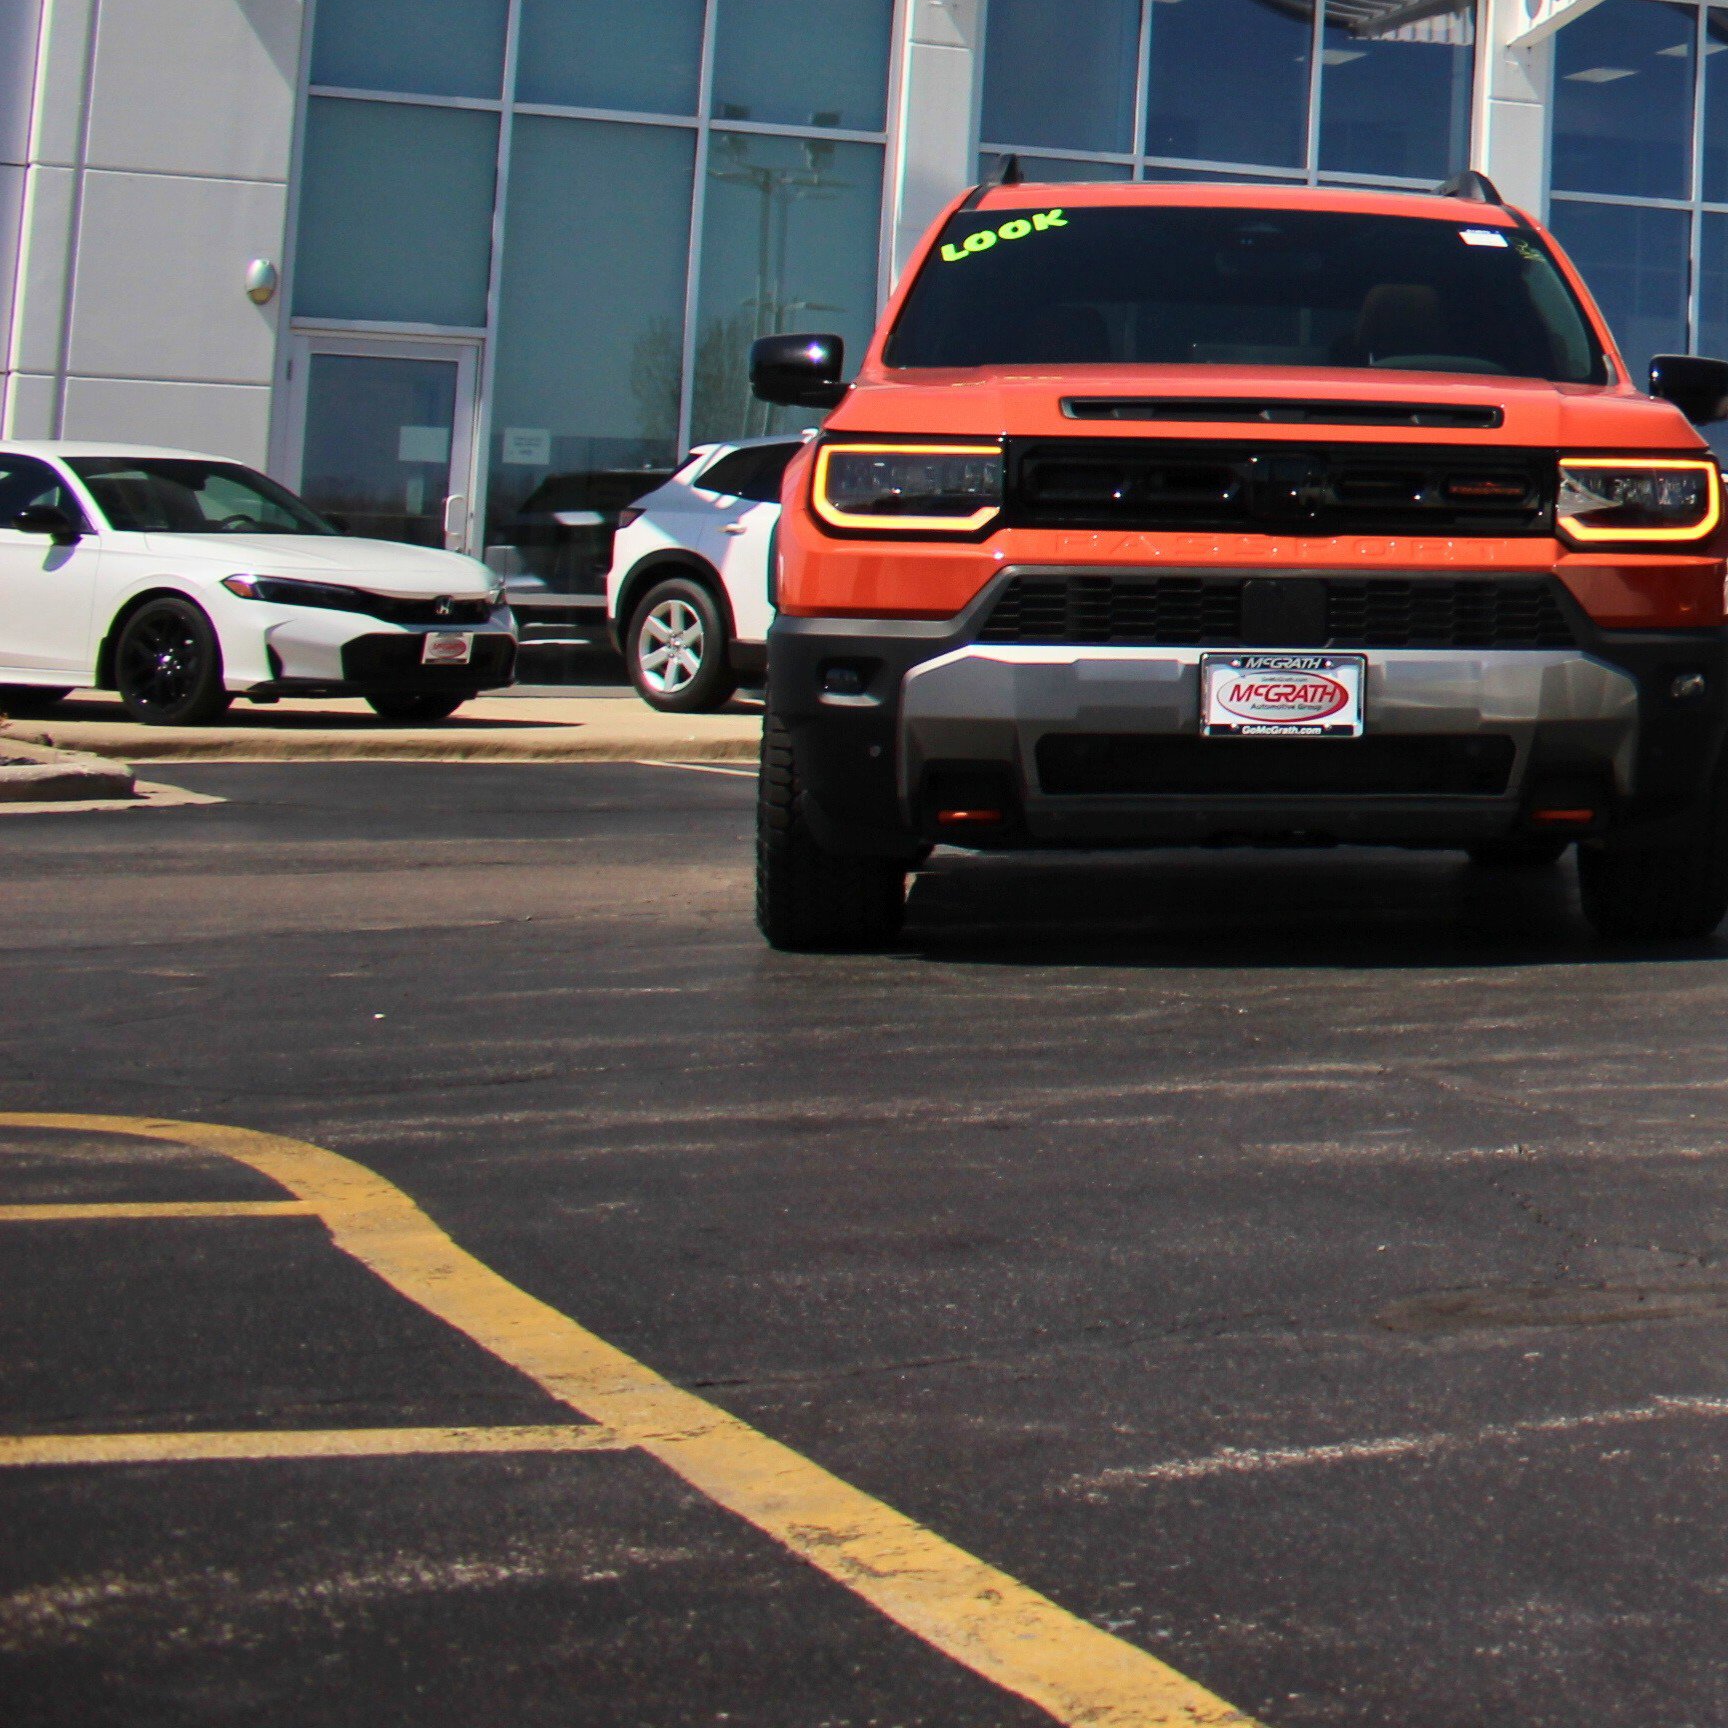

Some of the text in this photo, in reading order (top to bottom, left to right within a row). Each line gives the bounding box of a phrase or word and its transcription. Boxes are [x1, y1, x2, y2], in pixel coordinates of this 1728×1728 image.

[940, 208, 1069, 262] LOOK
[1054, 533, 1508, 560] PASSPORT
[1297, 703, 1322, 712] Group
